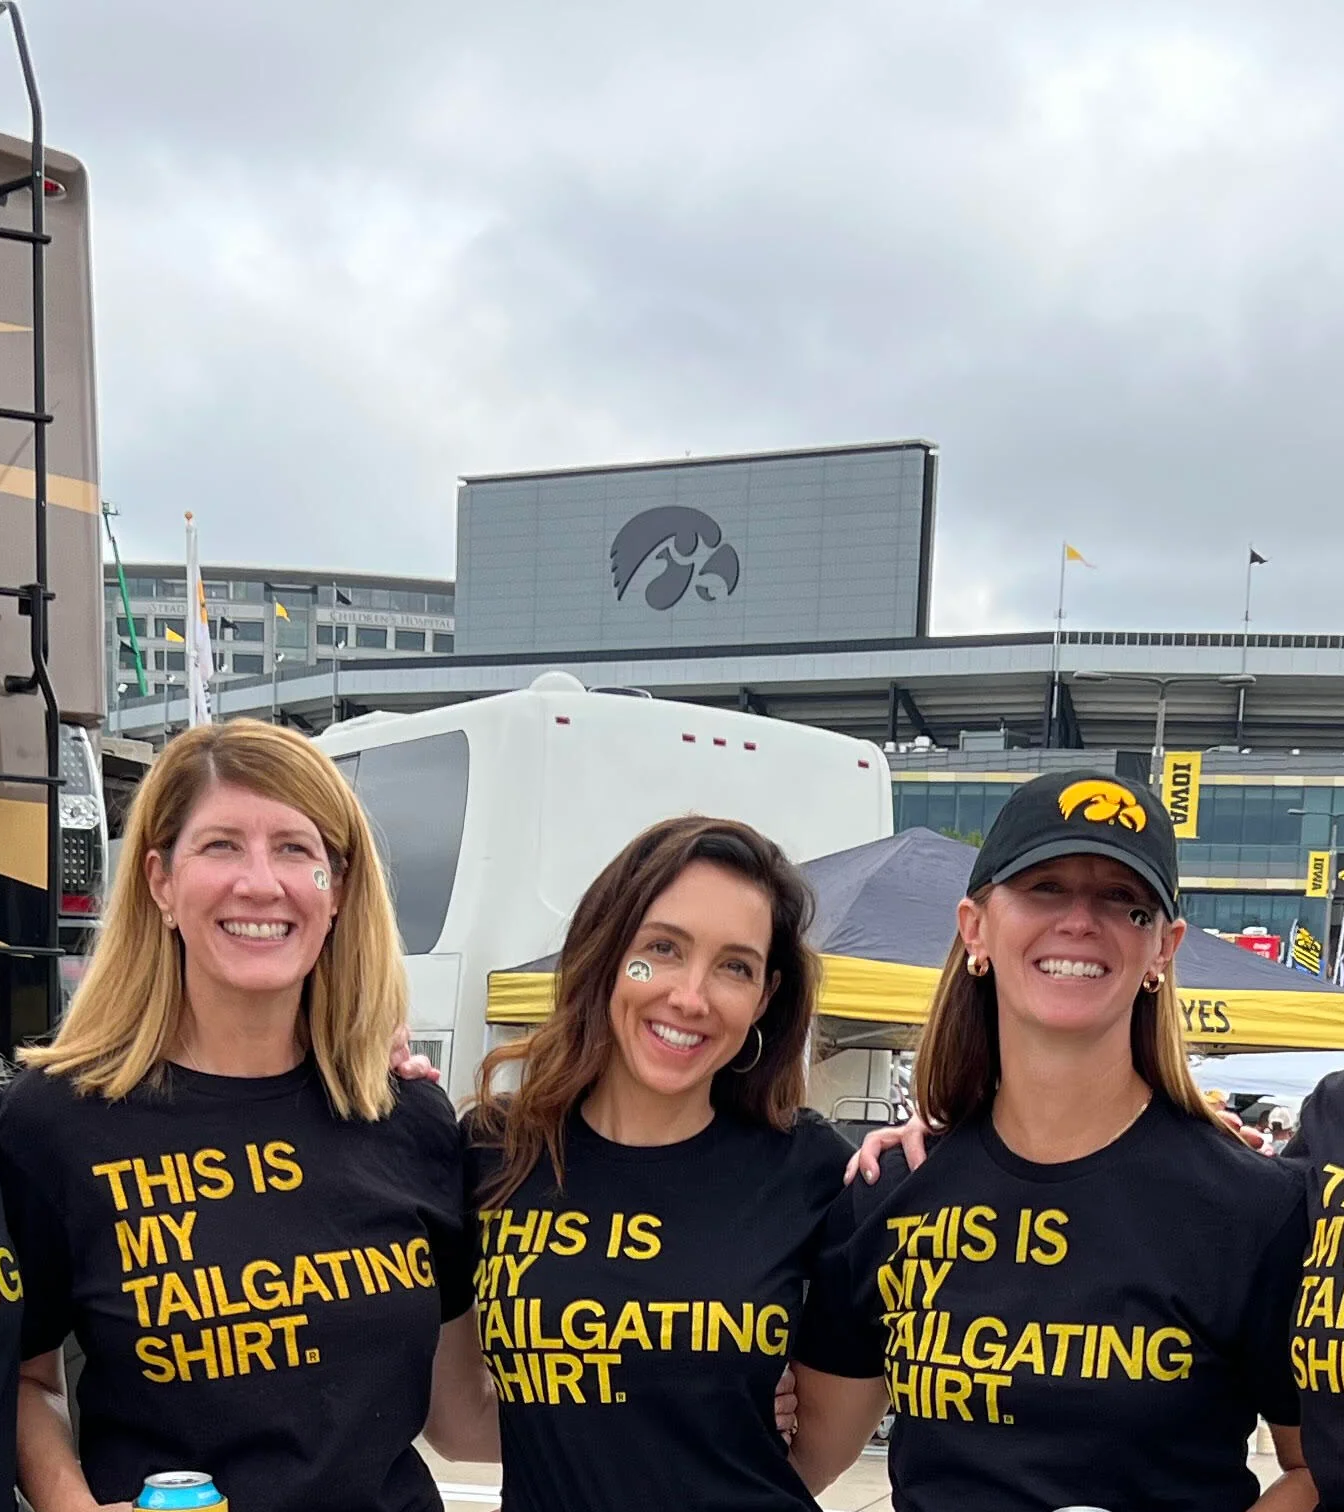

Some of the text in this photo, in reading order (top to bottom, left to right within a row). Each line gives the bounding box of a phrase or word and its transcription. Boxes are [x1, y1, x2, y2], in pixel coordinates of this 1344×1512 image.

[1169, 762, 1192, 826] IOWA
[1311, 857, 1325, 891] IOWA
[92, 1141, 304, 1211] THIS IS
[115, 1211, 197, 1272] MY
[478, 1208, 662, 1260] THIS IS
[886, 1205, 1070, 1265] THIS IS
[122, 1237, 435, 1327] TAILGATING
[473, 1254, 539, 1298] MY
[877, 1259, 953, 1311] MY
[476, 1298, 789, 1356] TAILGATING
[879, 1310, 1193, 1381] TAILGATING
